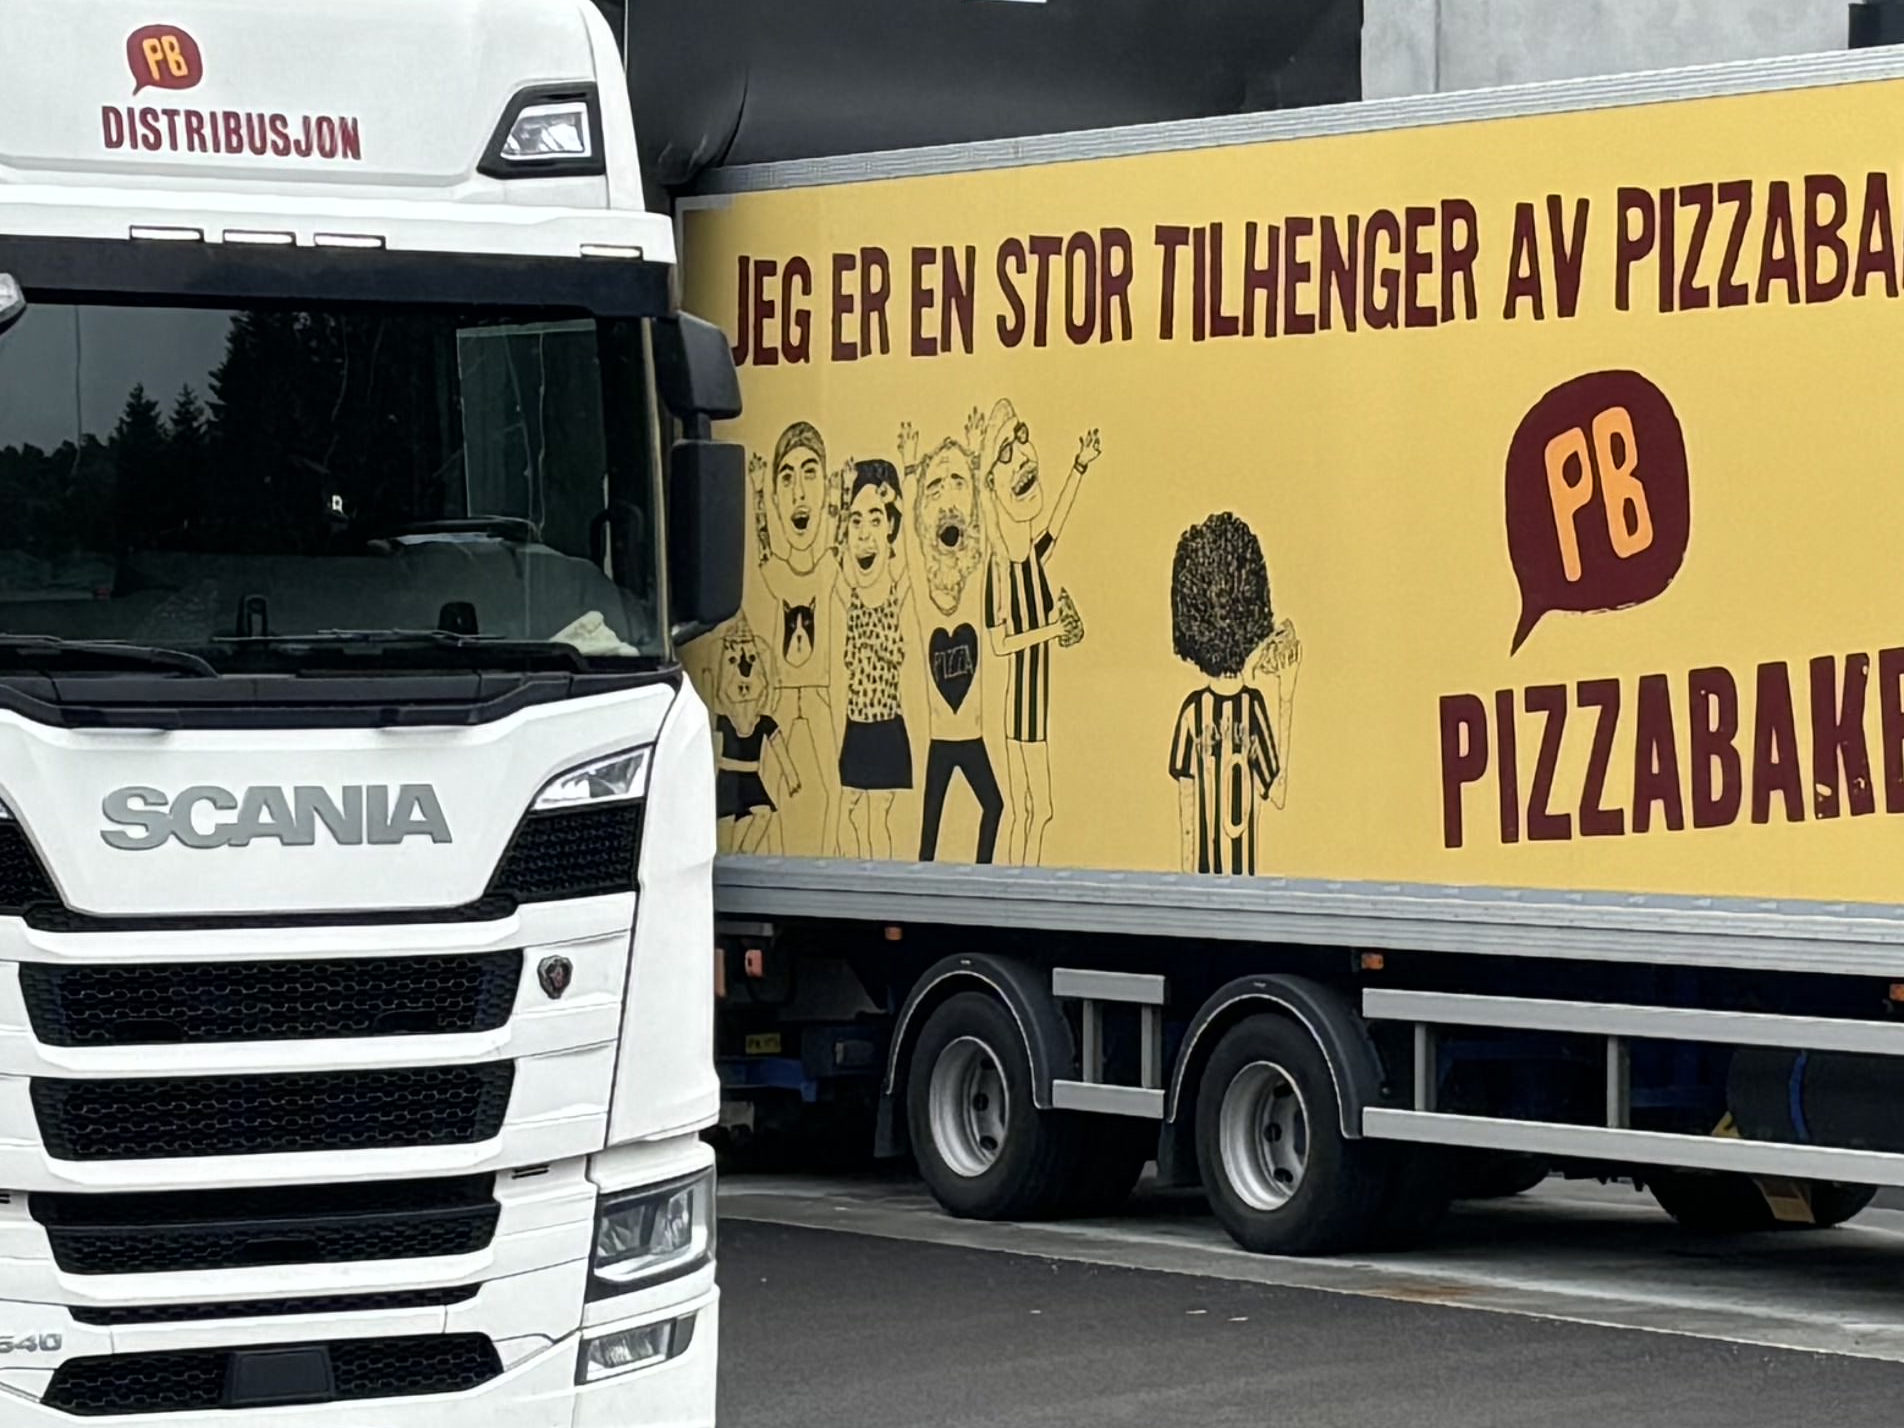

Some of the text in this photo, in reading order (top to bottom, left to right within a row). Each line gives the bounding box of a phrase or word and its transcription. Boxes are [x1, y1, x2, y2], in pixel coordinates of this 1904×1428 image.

[142, 35, 189, 81] PB
[101, 105, 361, 161] DISTRIBUSJON
[731, 254, 812, 368] JEG
[830, 246, 890, 362] ER
[910, 245, 976, 357] EN
[995, 227, 1134, 348] STOR
[1154, 198, 1479, 342] TILHENGER
[1503, 194, 1590, 321] AV
[1543, 405, 1654, 583] PB
[99, 783, 453, 852] SCANIA
